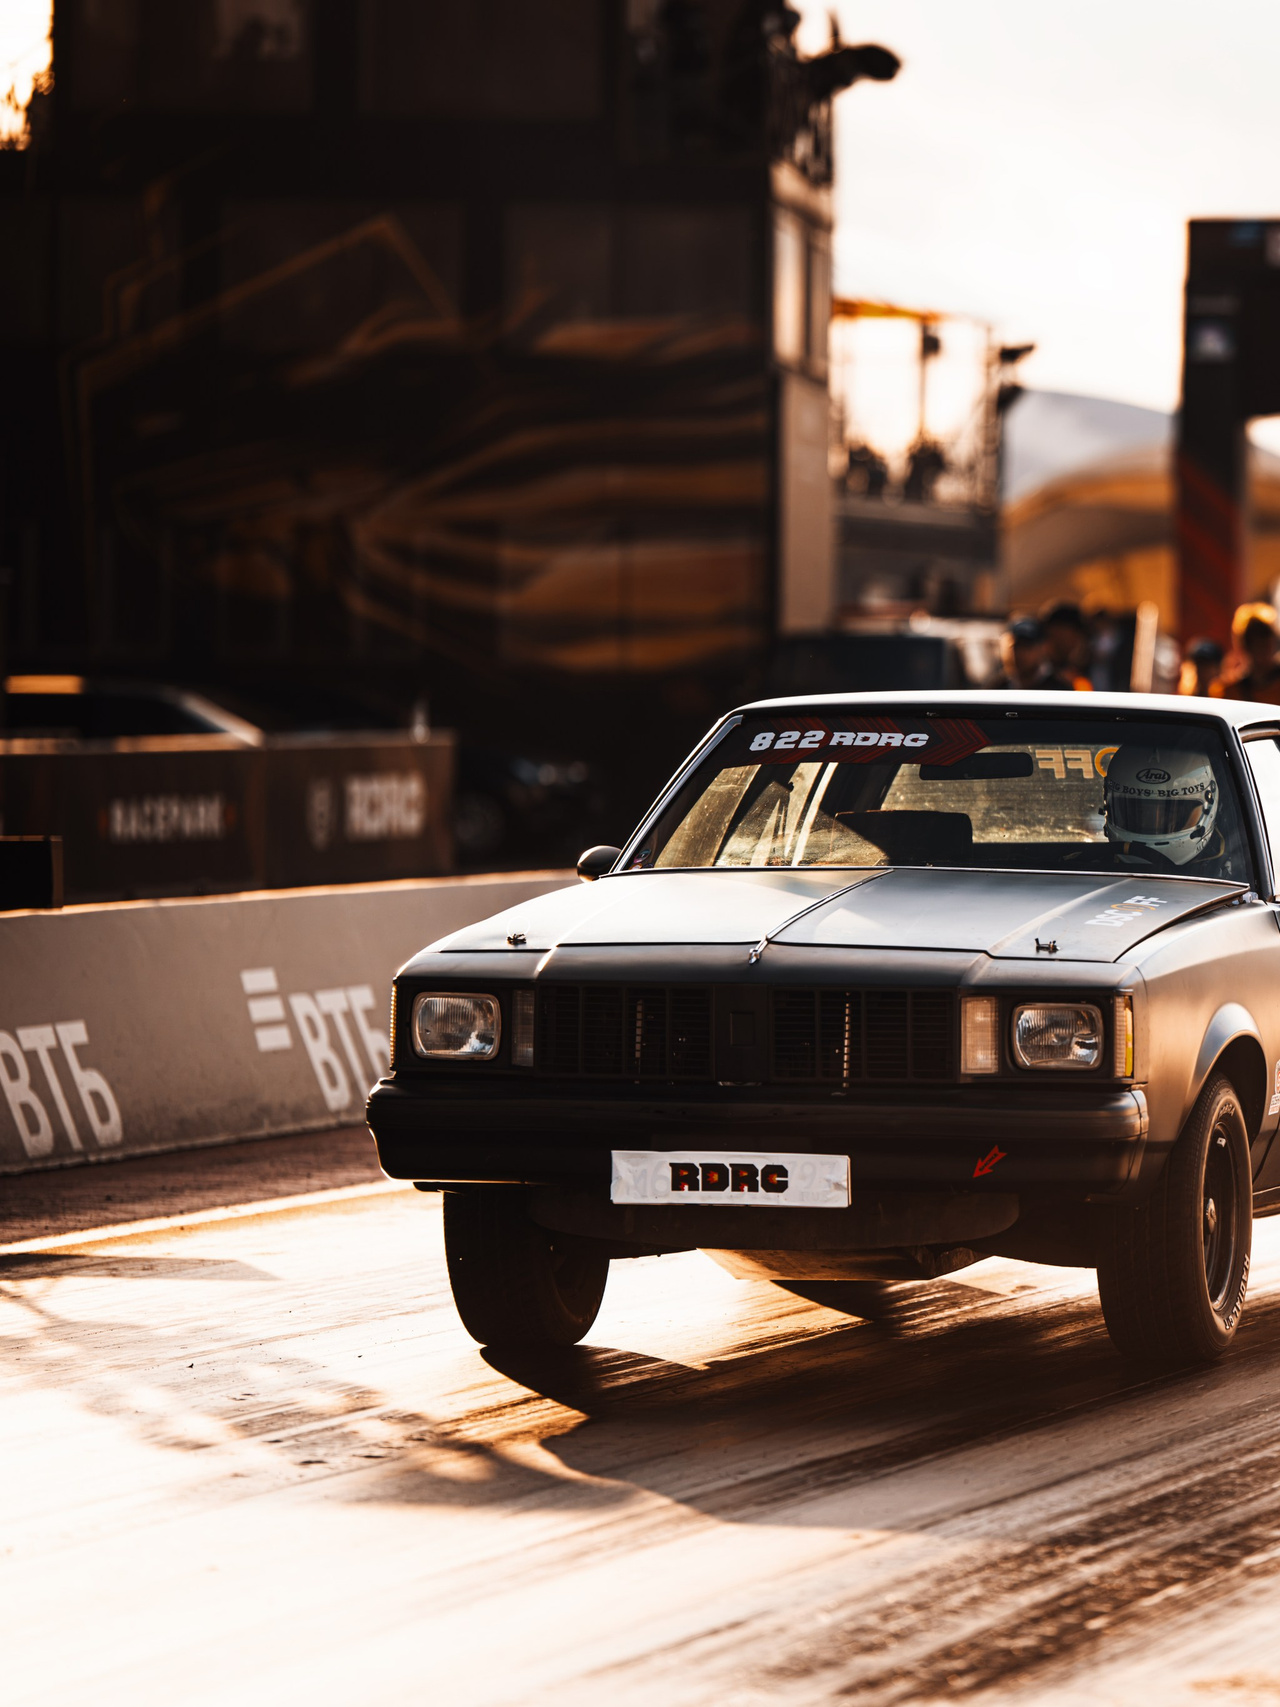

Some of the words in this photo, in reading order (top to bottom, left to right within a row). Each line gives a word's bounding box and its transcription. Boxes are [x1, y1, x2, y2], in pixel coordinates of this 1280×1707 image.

[749, 730, 826, 751] 822
[829, 731, 930, 748] RDRC
[1137, 768, 1168, 780] Arai
[1158, 789, 1179, 798] BIG
[1181, 782, 1205, 795] TOYS
[0, 1018, 123, 1158] ВТБ
[668, 1162, 789, 1194] RDRC
[1232, 1253, 1250, 1318] RADIAL
